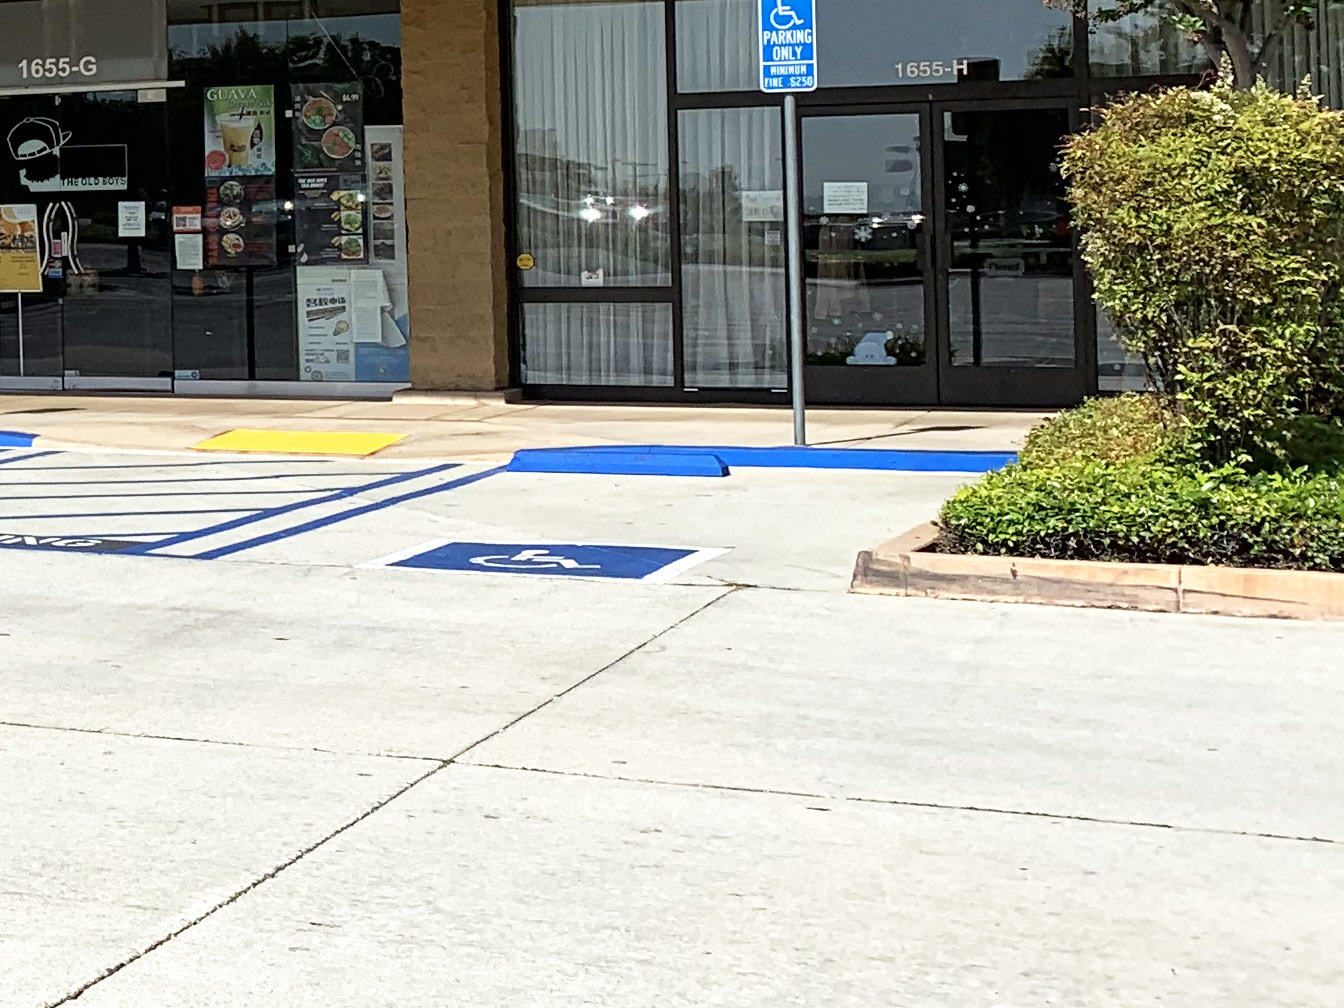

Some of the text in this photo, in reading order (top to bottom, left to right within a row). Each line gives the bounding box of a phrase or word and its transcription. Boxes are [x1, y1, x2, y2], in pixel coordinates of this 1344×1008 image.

[763, 29, 812, 45] PARKING
[772, 46, 803, 61] ONLY
[18, 56, 97, 79] 1655-G
[770, 65, 807, 76] MINIMUM
[895, 59, 968, 78] 1655-H
[765, 77, 784, 87] FINE
[206, 88, 258, 101] GUAVA
[61, 176, 127, 187] THE OLD BOYS
